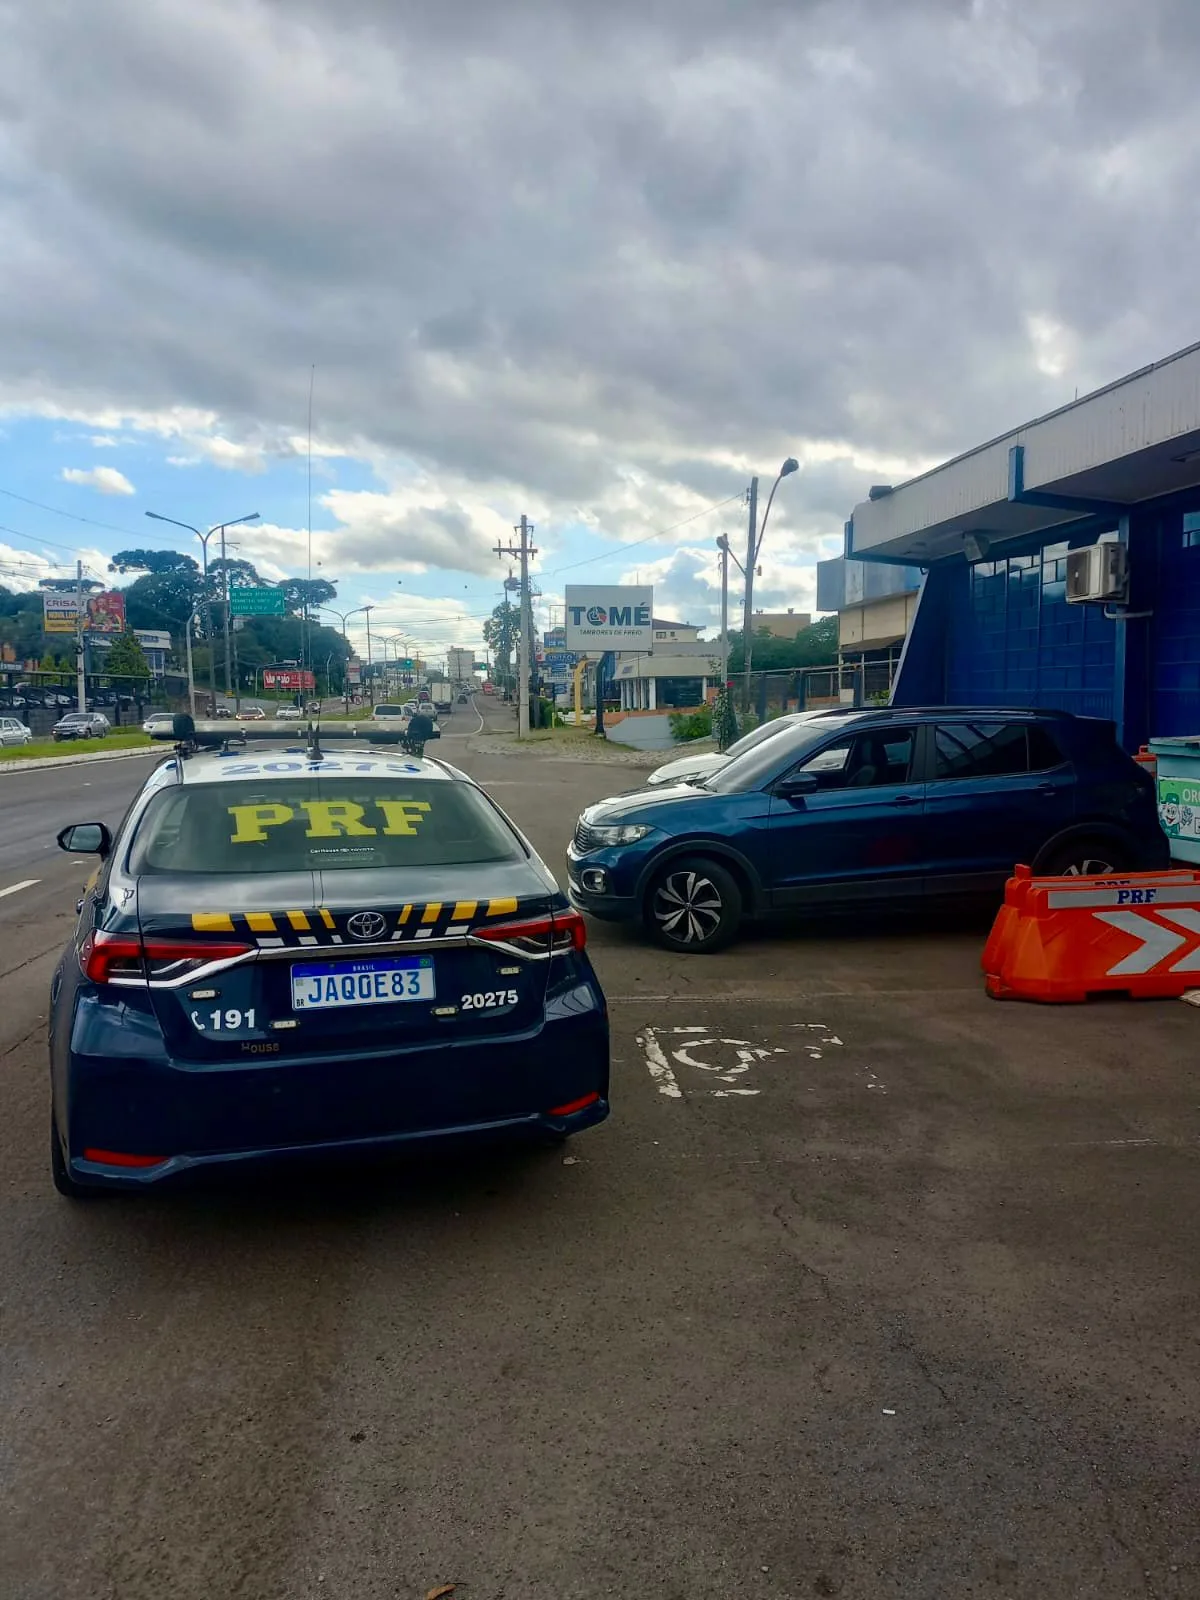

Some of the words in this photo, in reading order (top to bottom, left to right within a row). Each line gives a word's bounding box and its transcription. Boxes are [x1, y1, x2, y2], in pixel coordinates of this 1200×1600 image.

[568, 602, 651, 626] TOMÉ
[222, 760, 422, 776] 20275
[227, 801, 432, 844] PRF
[1117, 888, 1157, 905] PRF
[352, 964, 376, 972] BRASIL
[296, 998, 305, 1007] BR
[461, 988, 519, 1010] 20275
[210, 1008, 256, 1030] 191
[241, 1042, 280, 1054] House
